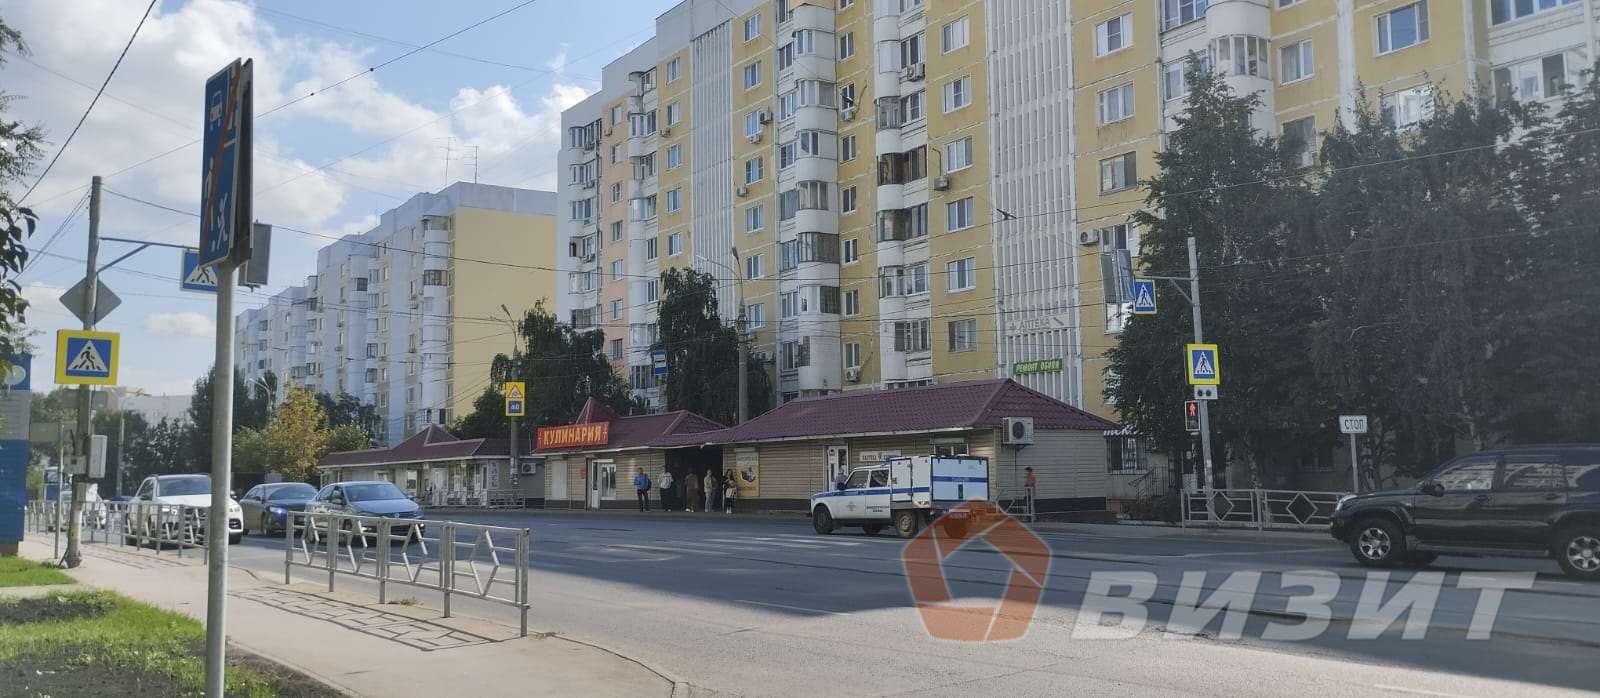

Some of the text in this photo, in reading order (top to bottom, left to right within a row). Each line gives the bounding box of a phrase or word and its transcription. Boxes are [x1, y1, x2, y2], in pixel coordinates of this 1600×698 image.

[1020, 318, 1050, 329] АПТЕКА
[1016, 360, 1060, 373] РЕМОНТ ОБУВИ
[1344, 419, 1364, 430] СТОП
[543, 425, 602, 445] КУЛИНАРИЯ
